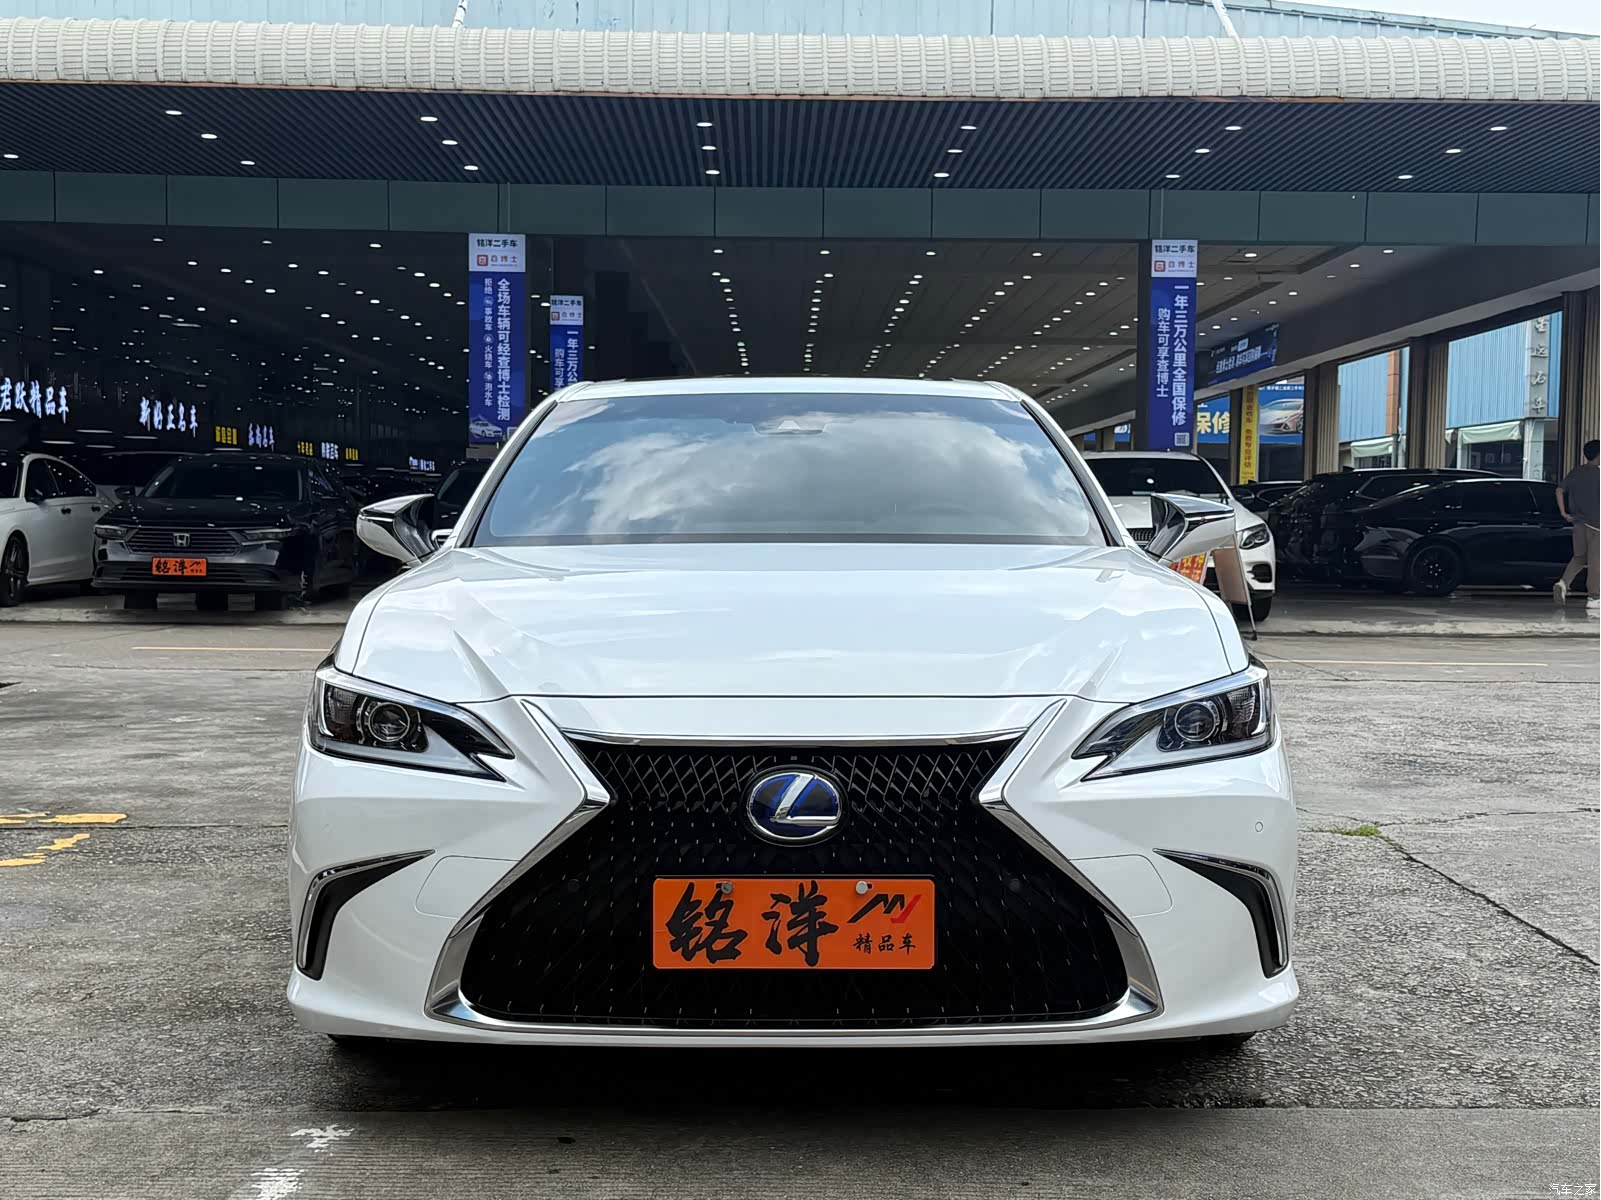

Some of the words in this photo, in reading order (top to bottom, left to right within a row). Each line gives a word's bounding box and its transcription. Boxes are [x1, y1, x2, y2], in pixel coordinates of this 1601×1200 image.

[477, 239, 518, 248] 铭洋二手车
[1155, 245, 1195, 253] 铭洋二手车
[484, 278, 493, 294] 拒绝
[484, 307, 493, 331] 事故车
[497, 278, 511, 421] 全场车辆可经查博士检测
[567, 331, 579, 386] 一年三万公
[1156, 308, 1171, 397] 购车可享查博士
[1172, 285, 1190, 426] 一年三万公里全国保修
[554, 348, 565, 391] 购车可享
[484, 382, 493, 406] 泡水车
[665, 880, 839, 967] 铭洋
[853, 932, 916, 955] 精品车
